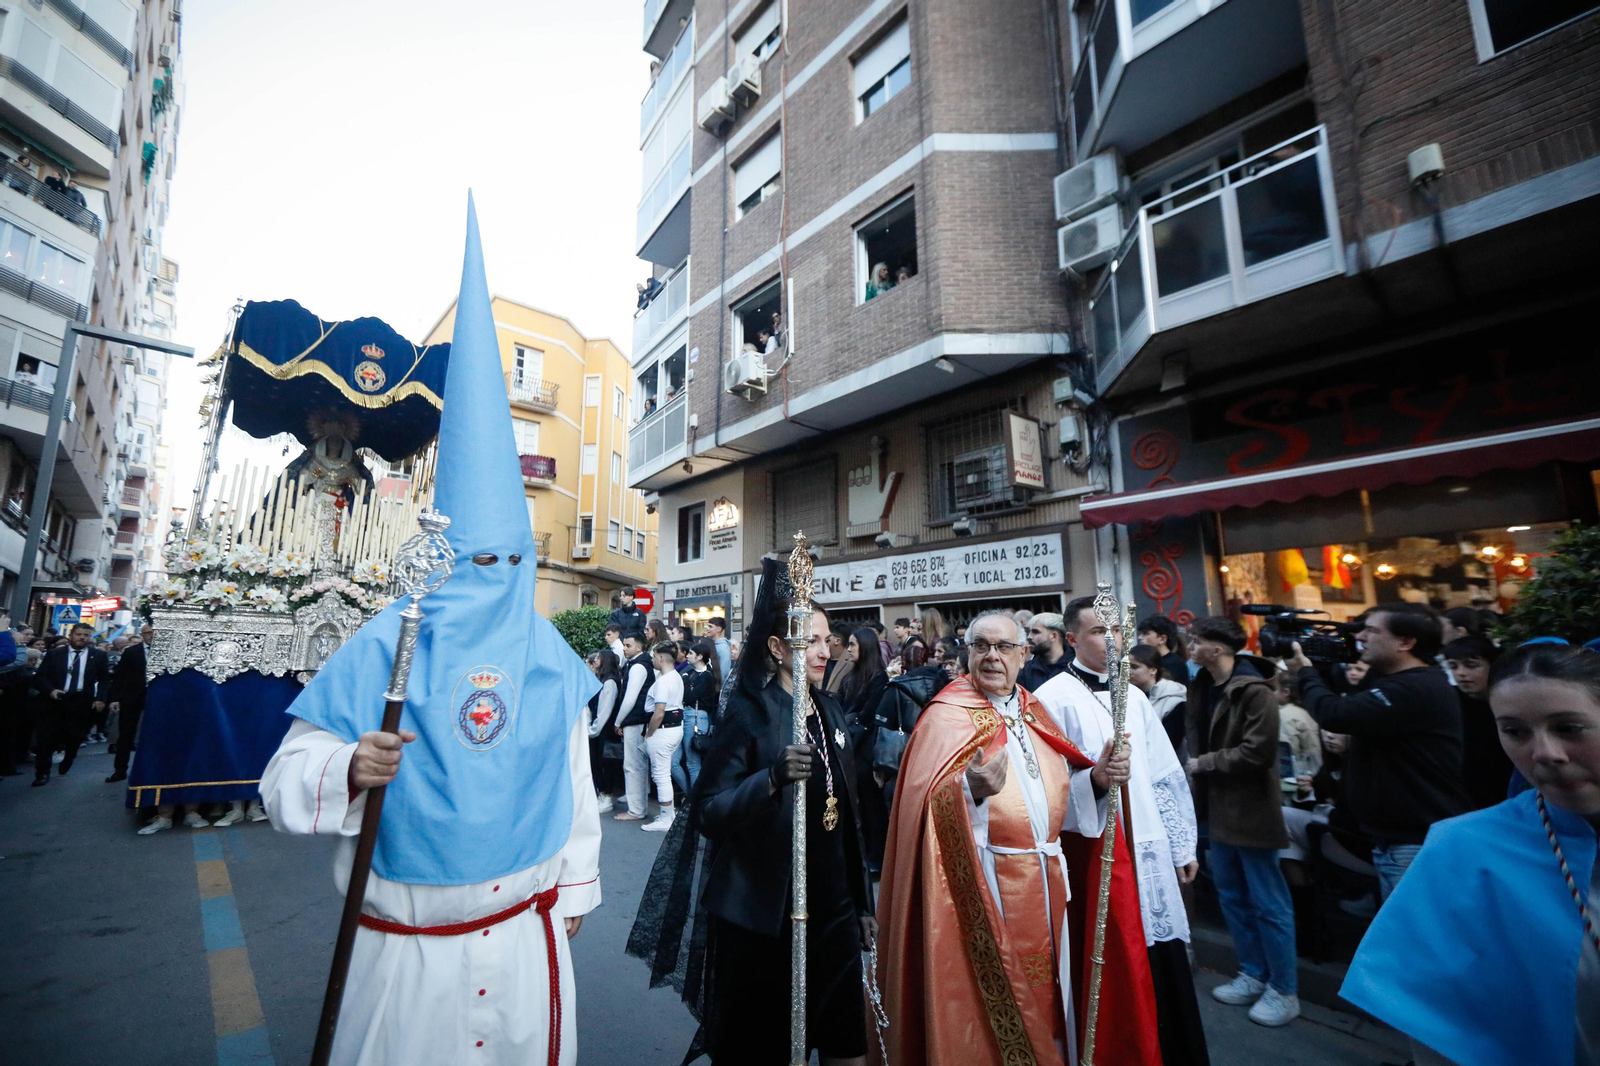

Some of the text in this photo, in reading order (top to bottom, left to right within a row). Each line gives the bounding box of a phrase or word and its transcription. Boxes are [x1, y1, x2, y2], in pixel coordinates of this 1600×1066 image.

[964, 548, 1008, 565] OFICINA
[1015, 542, 1048, 559] 92.23
[891, 556, 946, 576] 629 652 874
[964, 572, 970, 585] Y
[973, 569, 1006, 584] LOCAL
[1014, 565, 1049, 581] 213.20
[691, 583, 729, 597] MISTRAL
[893, 576, 908, 591] 617
